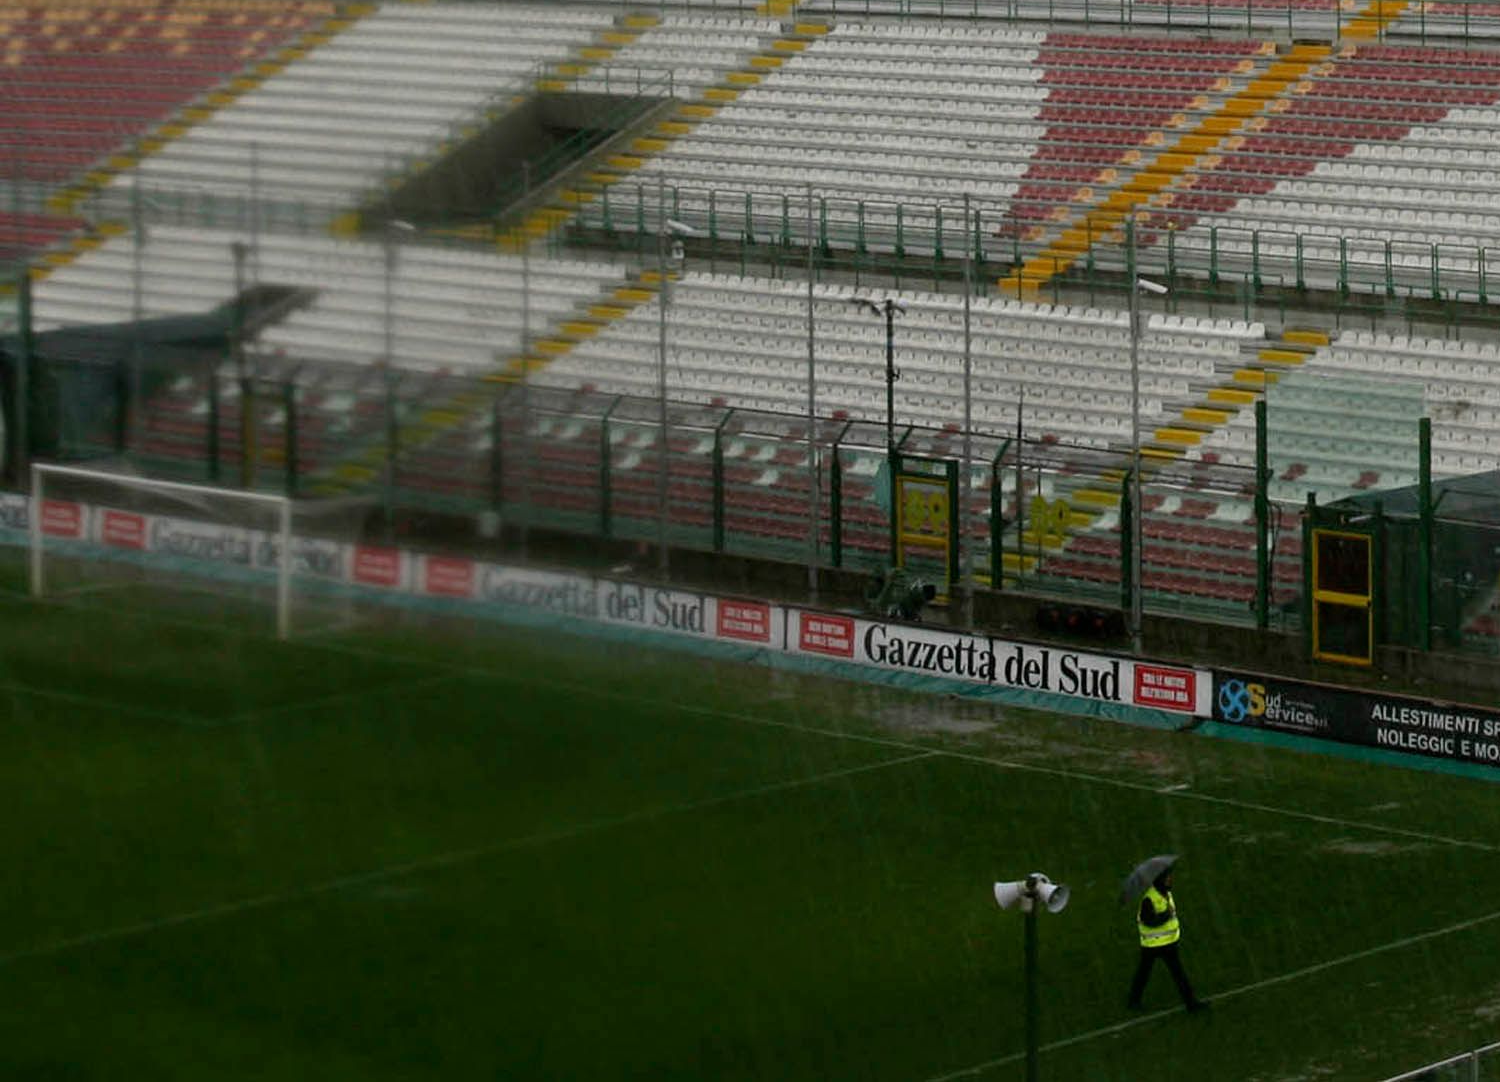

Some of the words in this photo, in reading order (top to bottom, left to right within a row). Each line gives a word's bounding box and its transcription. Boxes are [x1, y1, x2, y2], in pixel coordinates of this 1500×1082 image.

[608, 581, 646, 623] del
[654, 589, 705, 632] Sud
[864, 623, 996, 680] Gazzetta
[1005, 645, 1051, 691] del
[1059, 654, 1122, 701] Sud
[1371, 703, 1479, 735] ALLESTIMENTI
[1461, 740, 1471, 756] E
